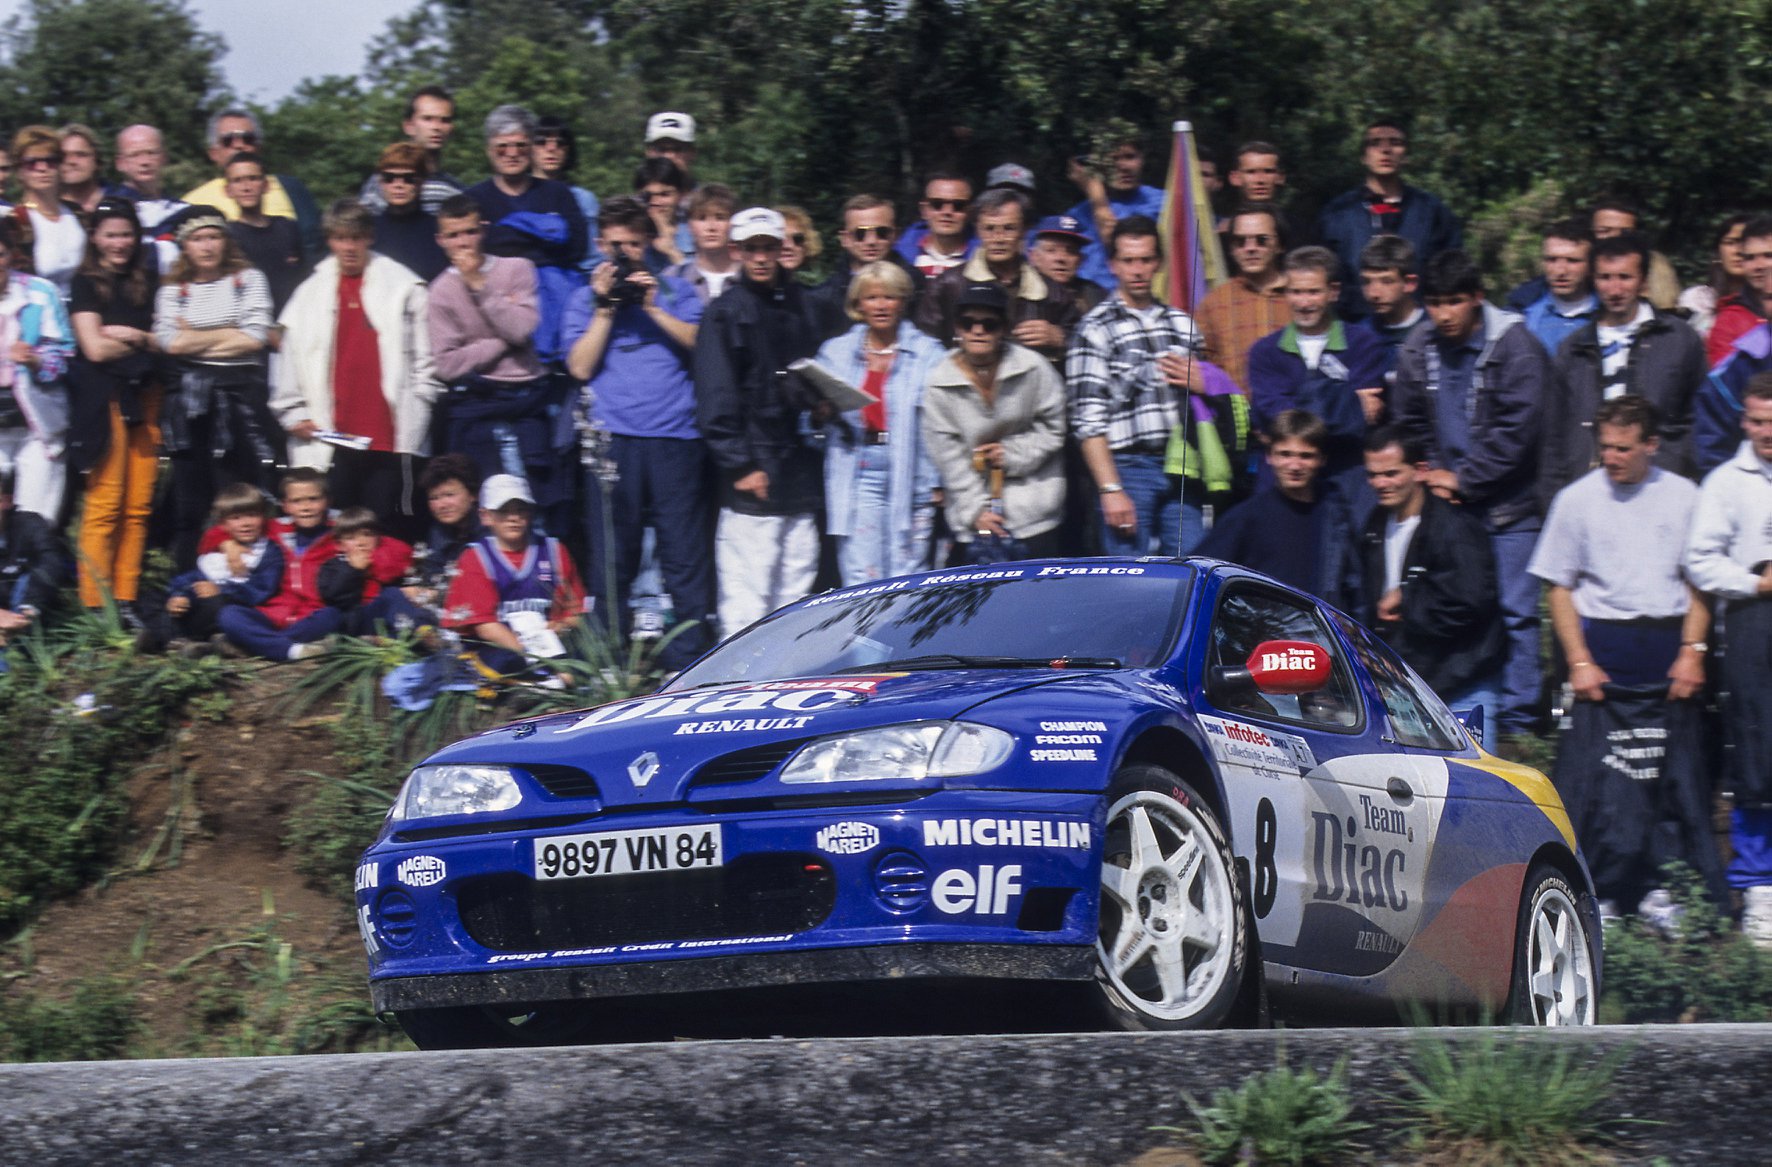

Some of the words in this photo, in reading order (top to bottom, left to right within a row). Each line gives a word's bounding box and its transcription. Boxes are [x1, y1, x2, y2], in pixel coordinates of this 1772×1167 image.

[803, 581, 910, 608] Renault
[1038, 566, 1145, 576] France
[1261, 653, 1316, 671] Diac
[1287, 648, 1315, 656] Team
[553, 689, 859, 734] Diac
[673, 716, 814, 735] RENAULT
[1040, 721, 1108, 732] CHAMPION
[1222, 721, 1270, 747] infotec
[1029, 749, 1098, 761] SPEEDLINE
[1359, 794, 1406, 835] Team
[923, 819, 1091, 849] MICHELIN
[543, 837, 617, 878] 9897
[625, 834, 668, 871] VN
[676, 831, 716, 867] 84
[1254, 797, 1278, 919] 8
[1311, 811, 1408, 912] Diac
[931, 865, 1022, 914] elf
[1539, 877, 1577, 906] MICHELIN
[487, 951, 547, 964] groupe
[552, 946, 616, 957] Renault
[678, 934, 793, 948] International
[1355, 930, 1400, 954] RENAULT
